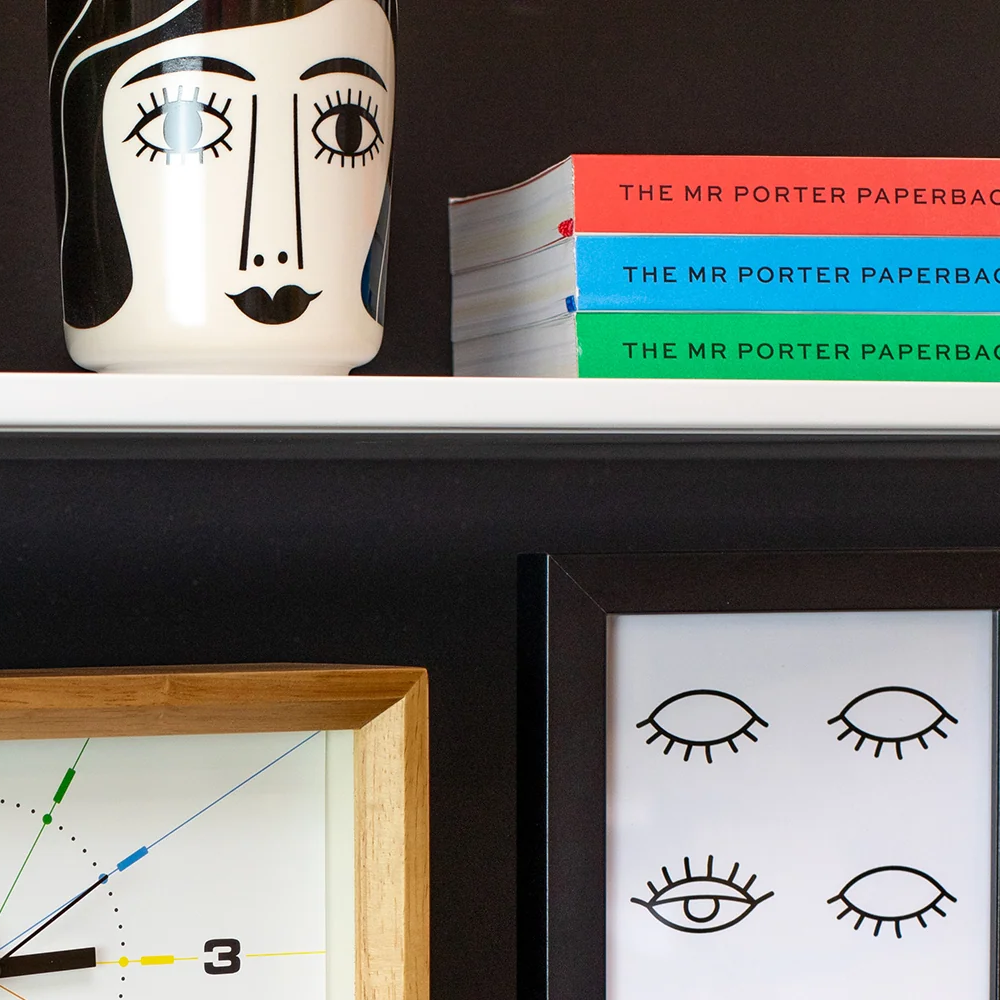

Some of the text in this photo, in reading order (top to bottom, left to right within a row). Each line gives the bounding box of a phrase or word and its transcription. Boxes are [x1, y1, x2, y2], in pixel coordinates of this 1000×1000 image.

[619, 184, 674, 202] THE
[684, 185, 723, 203] MR
[734, 186, 846, 204] PORTER
[623, 266, 678, 283] THE
[688, 266, 727, 283] MR
[738, 266, 850, 284] PORTER
[623, 342, 678, 360] THE
[688, 342, 727, 360] MR
[738, 342, 850, 361] PORTER
[203, 938, 241, 975] 3
